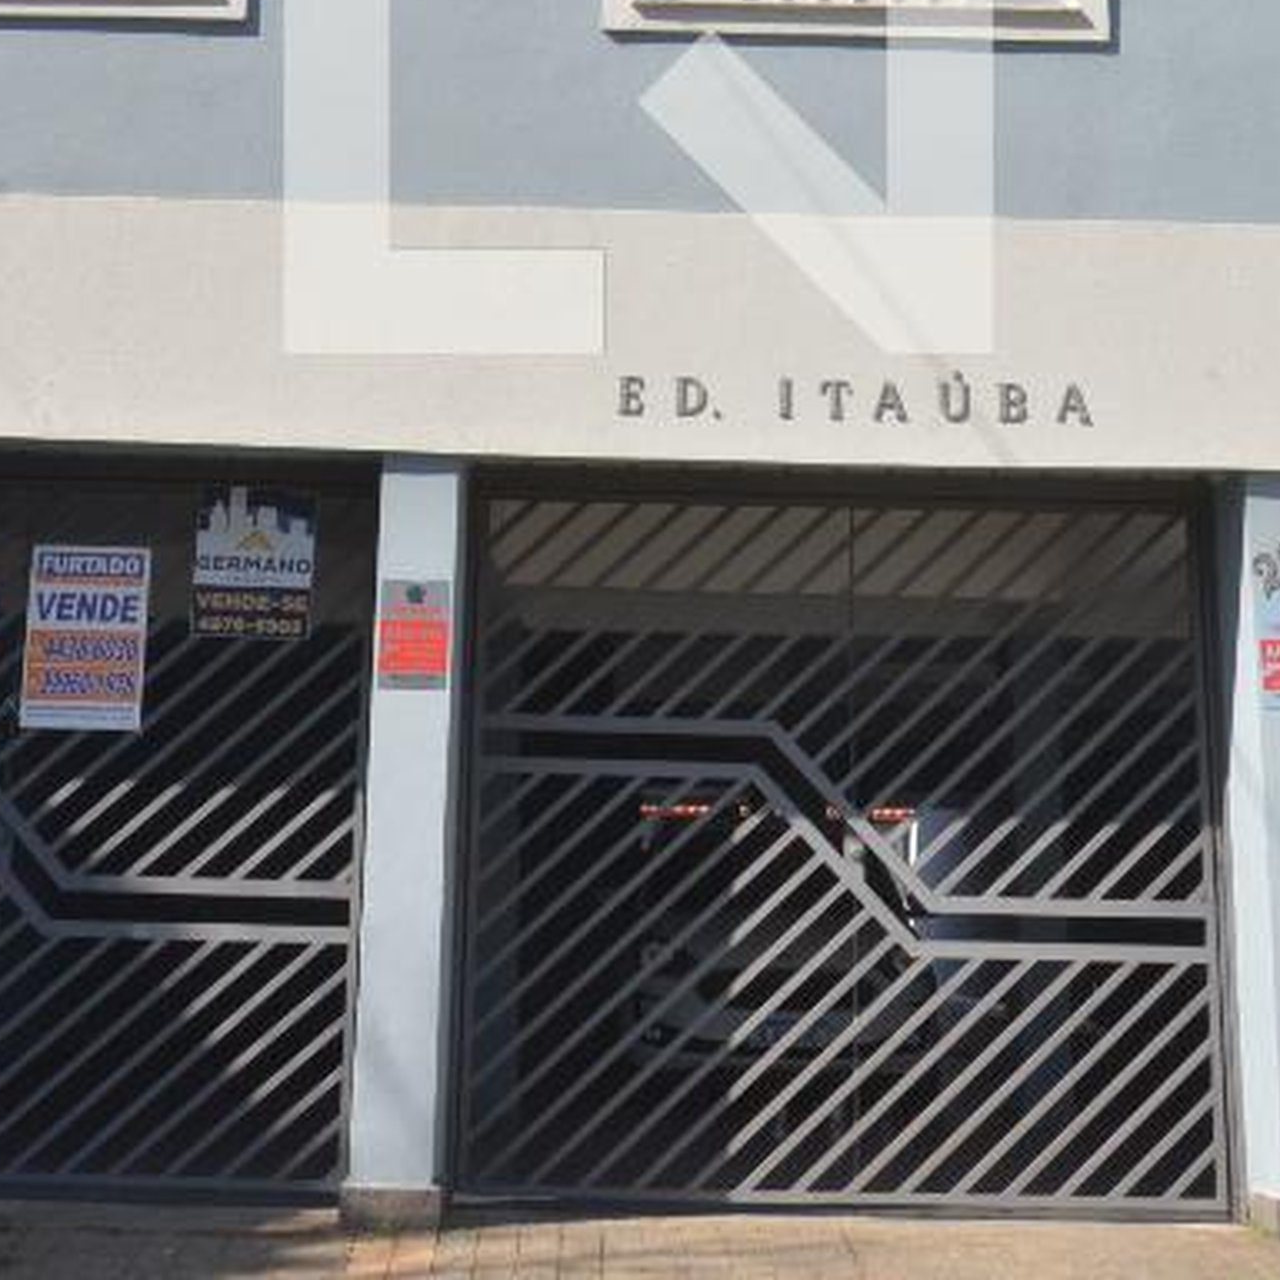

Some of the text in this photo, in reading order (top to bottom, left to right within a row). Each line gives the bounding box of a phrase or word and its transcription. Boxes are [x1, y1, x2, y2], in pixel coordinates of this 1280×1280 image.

[618, 375, 721, 421] ED.
[42, 555, 142, 575] FURTADO
[199, 555, 312, 575] GERMANO
[37, 591, 141, 623] VENDE
